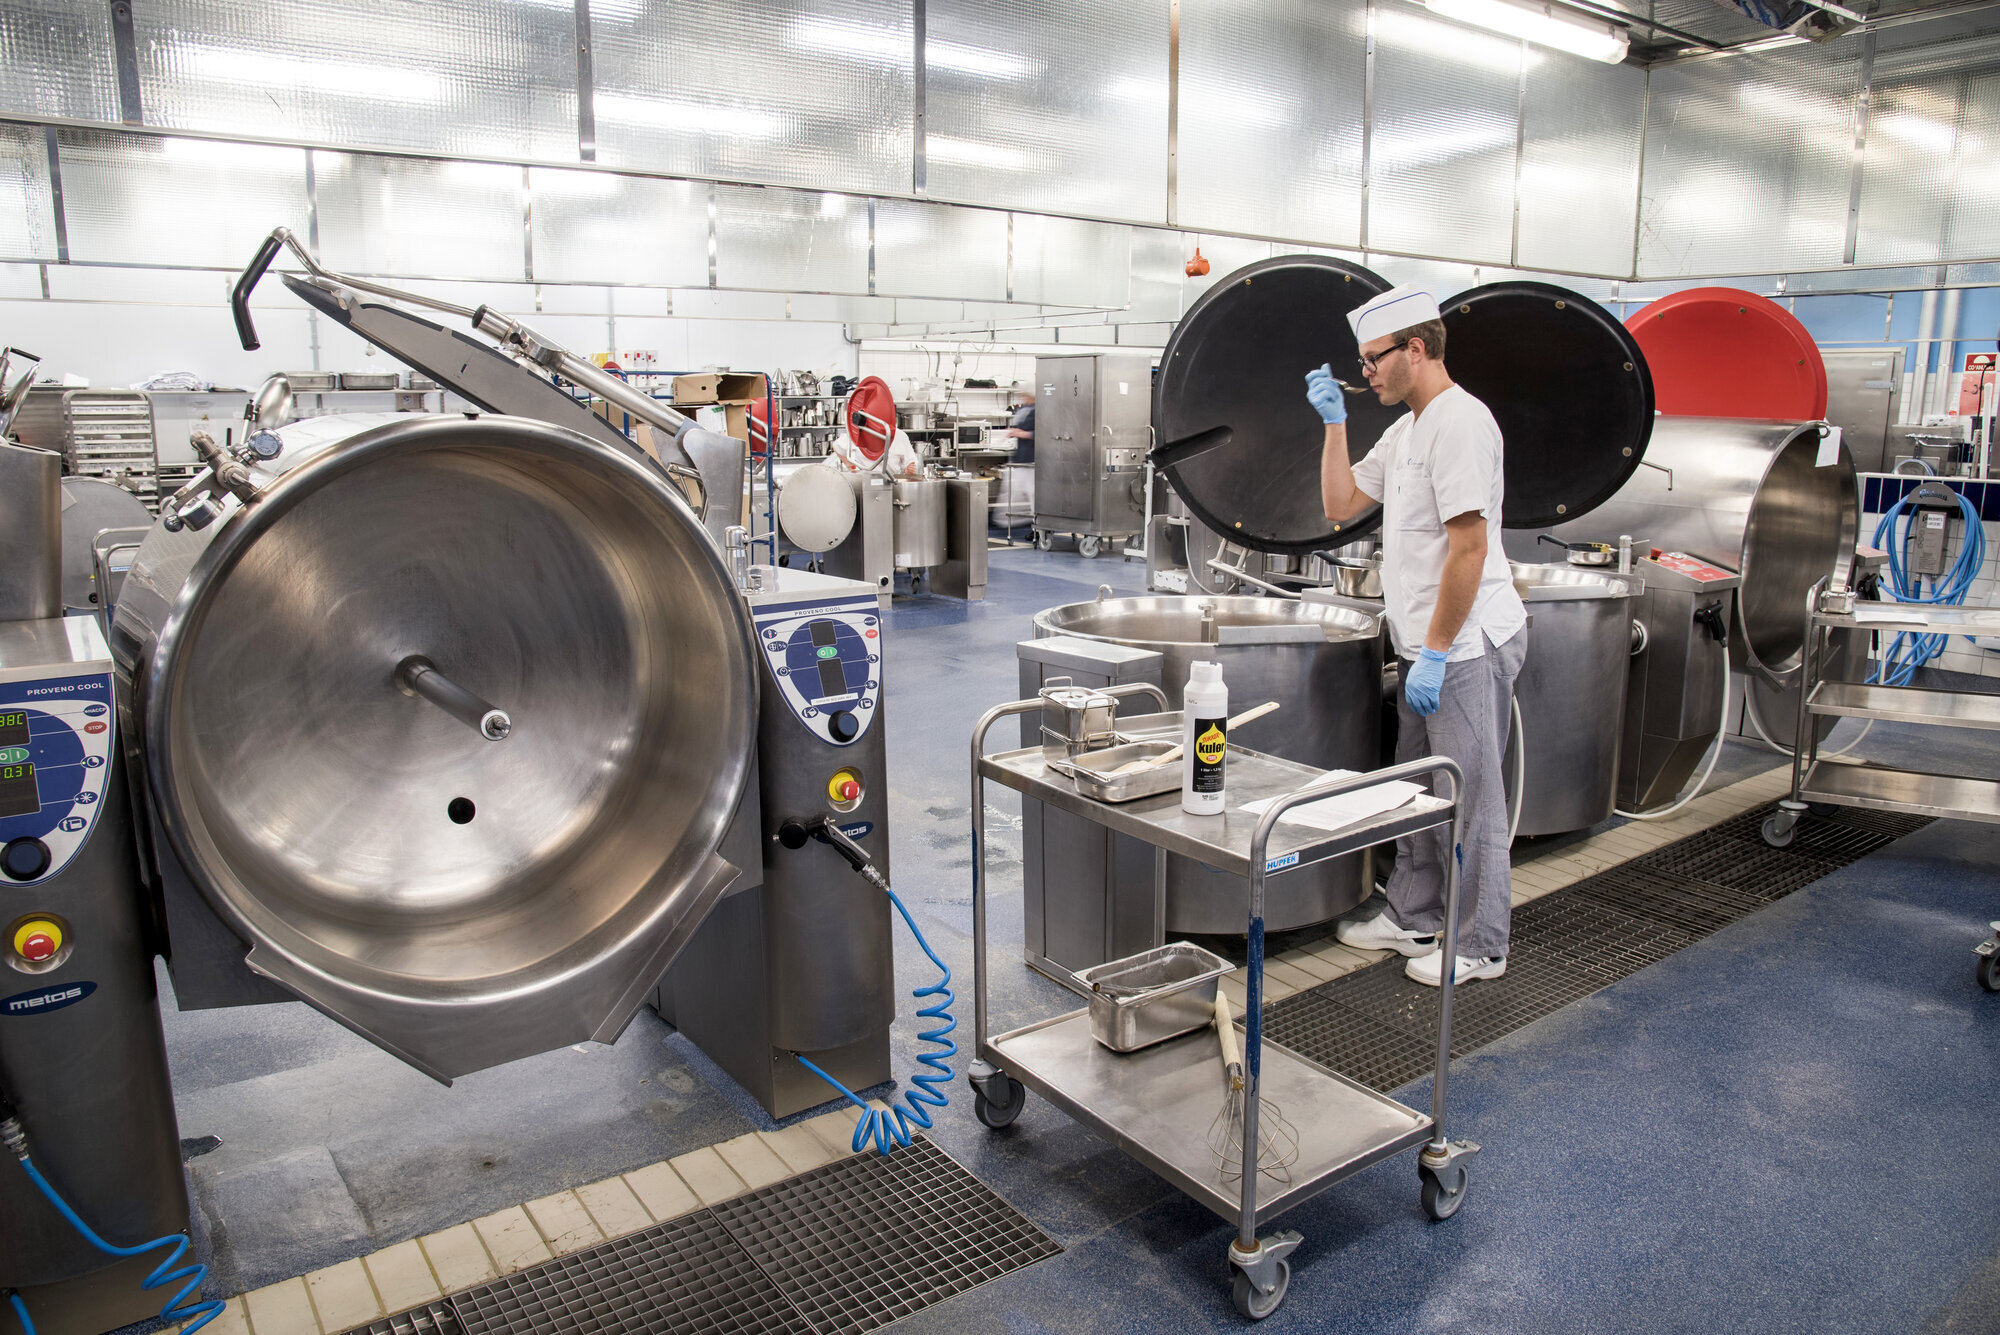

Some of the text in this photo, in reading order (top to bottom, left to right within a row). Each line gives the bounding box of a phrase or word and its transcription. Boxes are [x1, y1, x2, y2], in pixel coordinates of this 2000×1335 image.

[794, 608, 824, 616] PROVENO
[27, 682, 105, 696] PROVENO COOL
[1267, 855, 1296, 870] HUPFER
[9, 987, 82, 1011] metos
